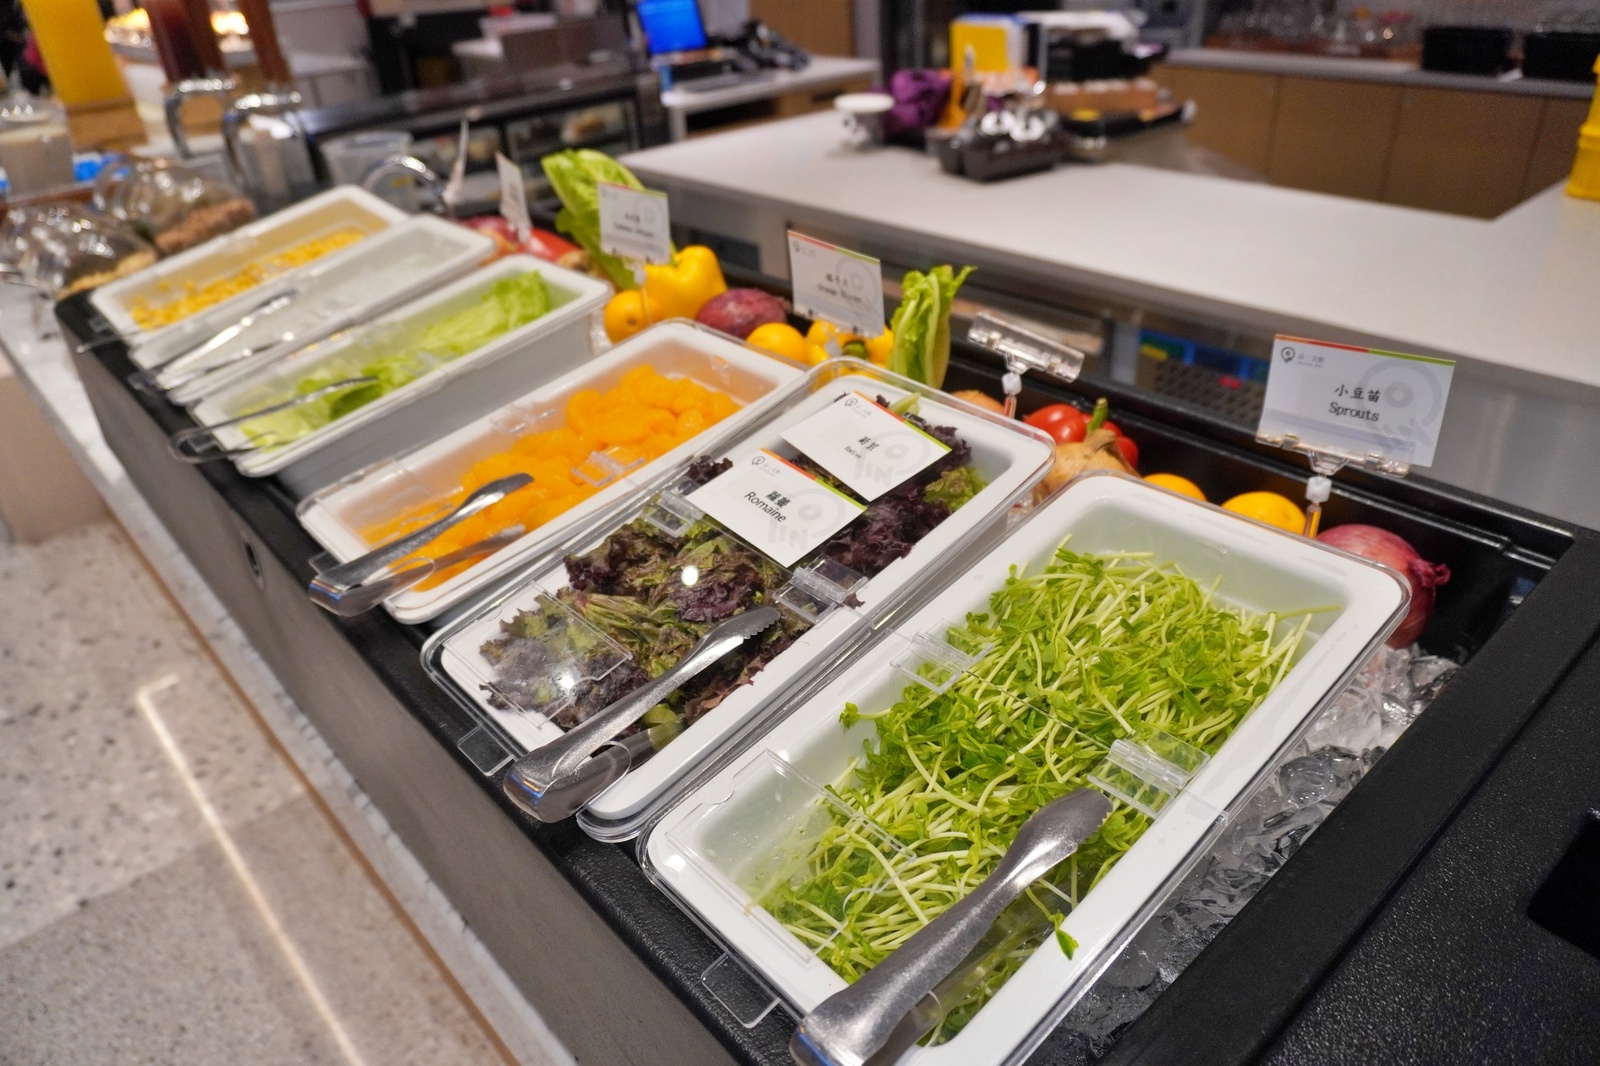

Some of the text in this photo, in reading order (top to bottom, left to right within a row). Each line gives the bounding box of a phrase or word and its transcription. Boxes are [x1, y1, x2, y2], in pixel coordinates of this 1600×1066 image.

[1335, 384, 1381, 403] 小豆苗
[1329, 401, 1380, 422] Sprouts
[744, 491, 787, 523] Romaine
